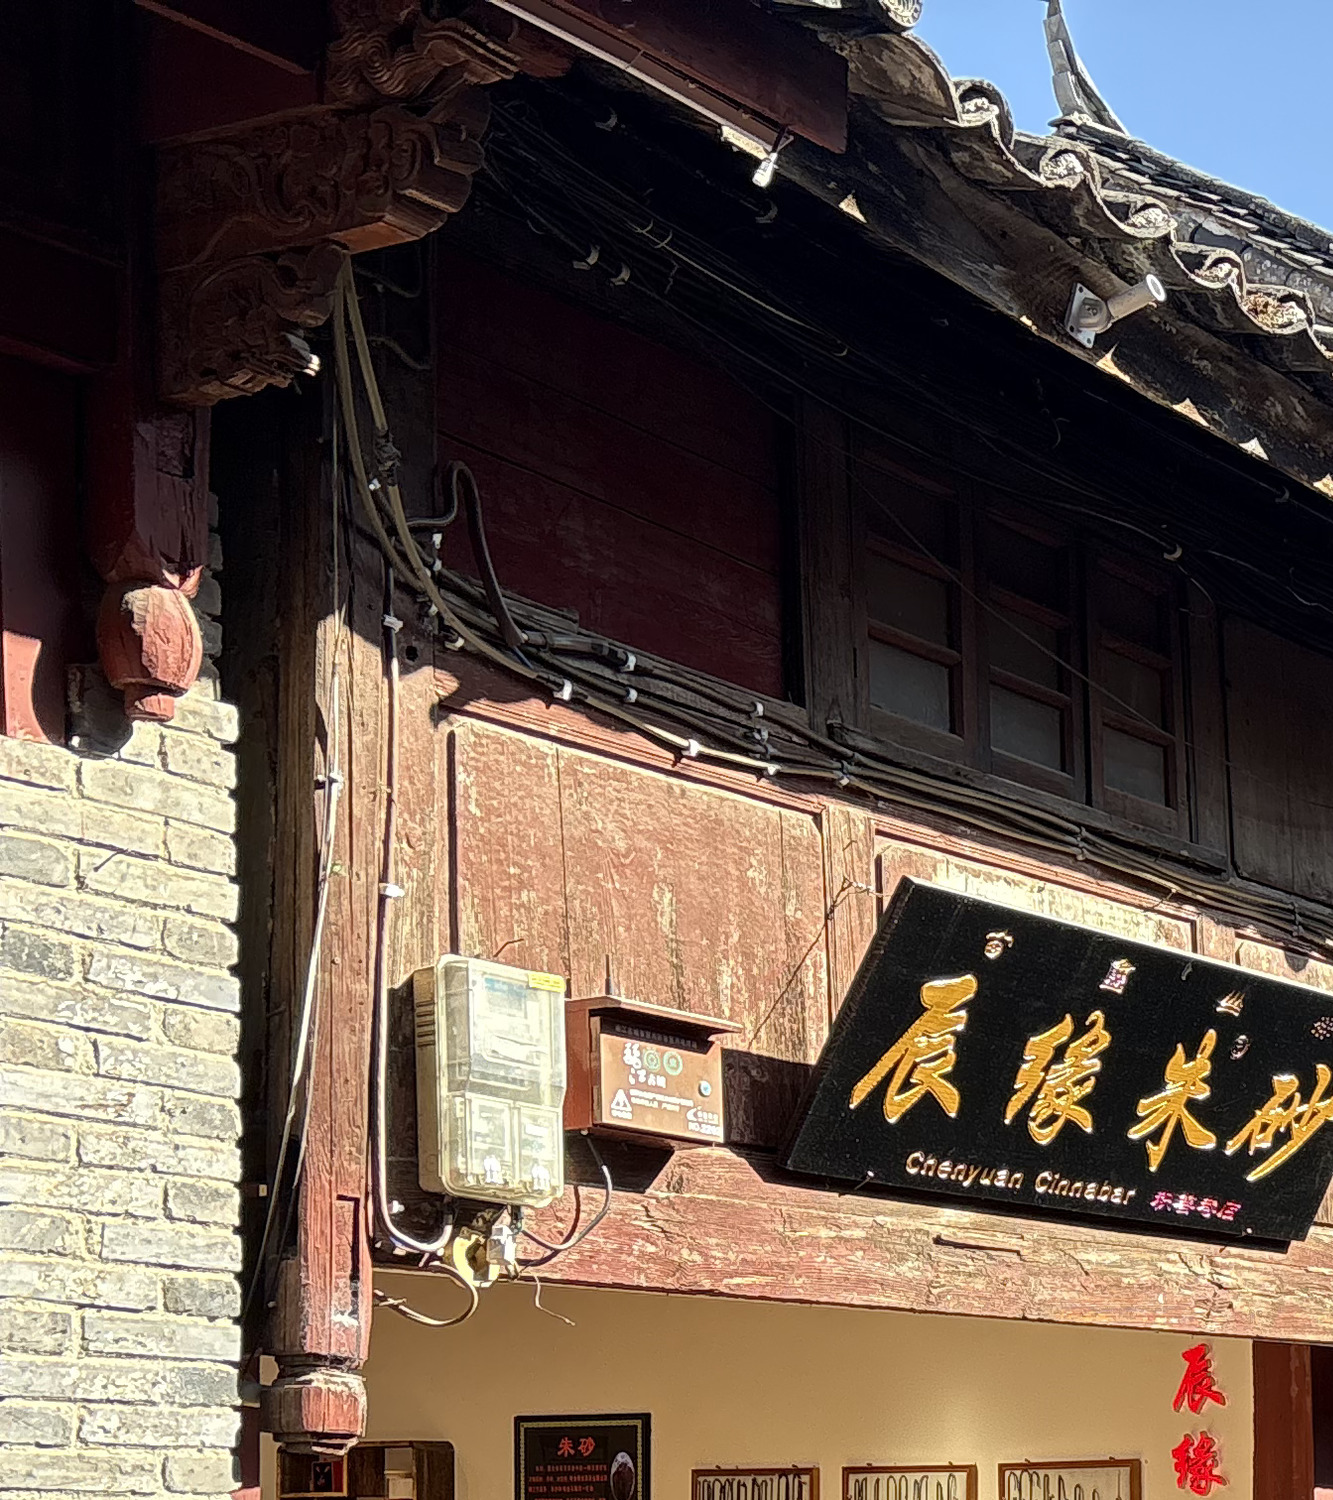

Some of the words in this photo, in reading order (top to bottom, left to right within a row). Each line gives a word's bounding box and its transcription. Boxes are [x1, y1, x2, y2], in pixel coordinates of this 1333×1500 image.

[905, 1150, 1025, 1188] Chenyuan
[1034, 1170, 1136, 1205] Cinnabar
[557, 1436, 596, 1458] 朱砂
